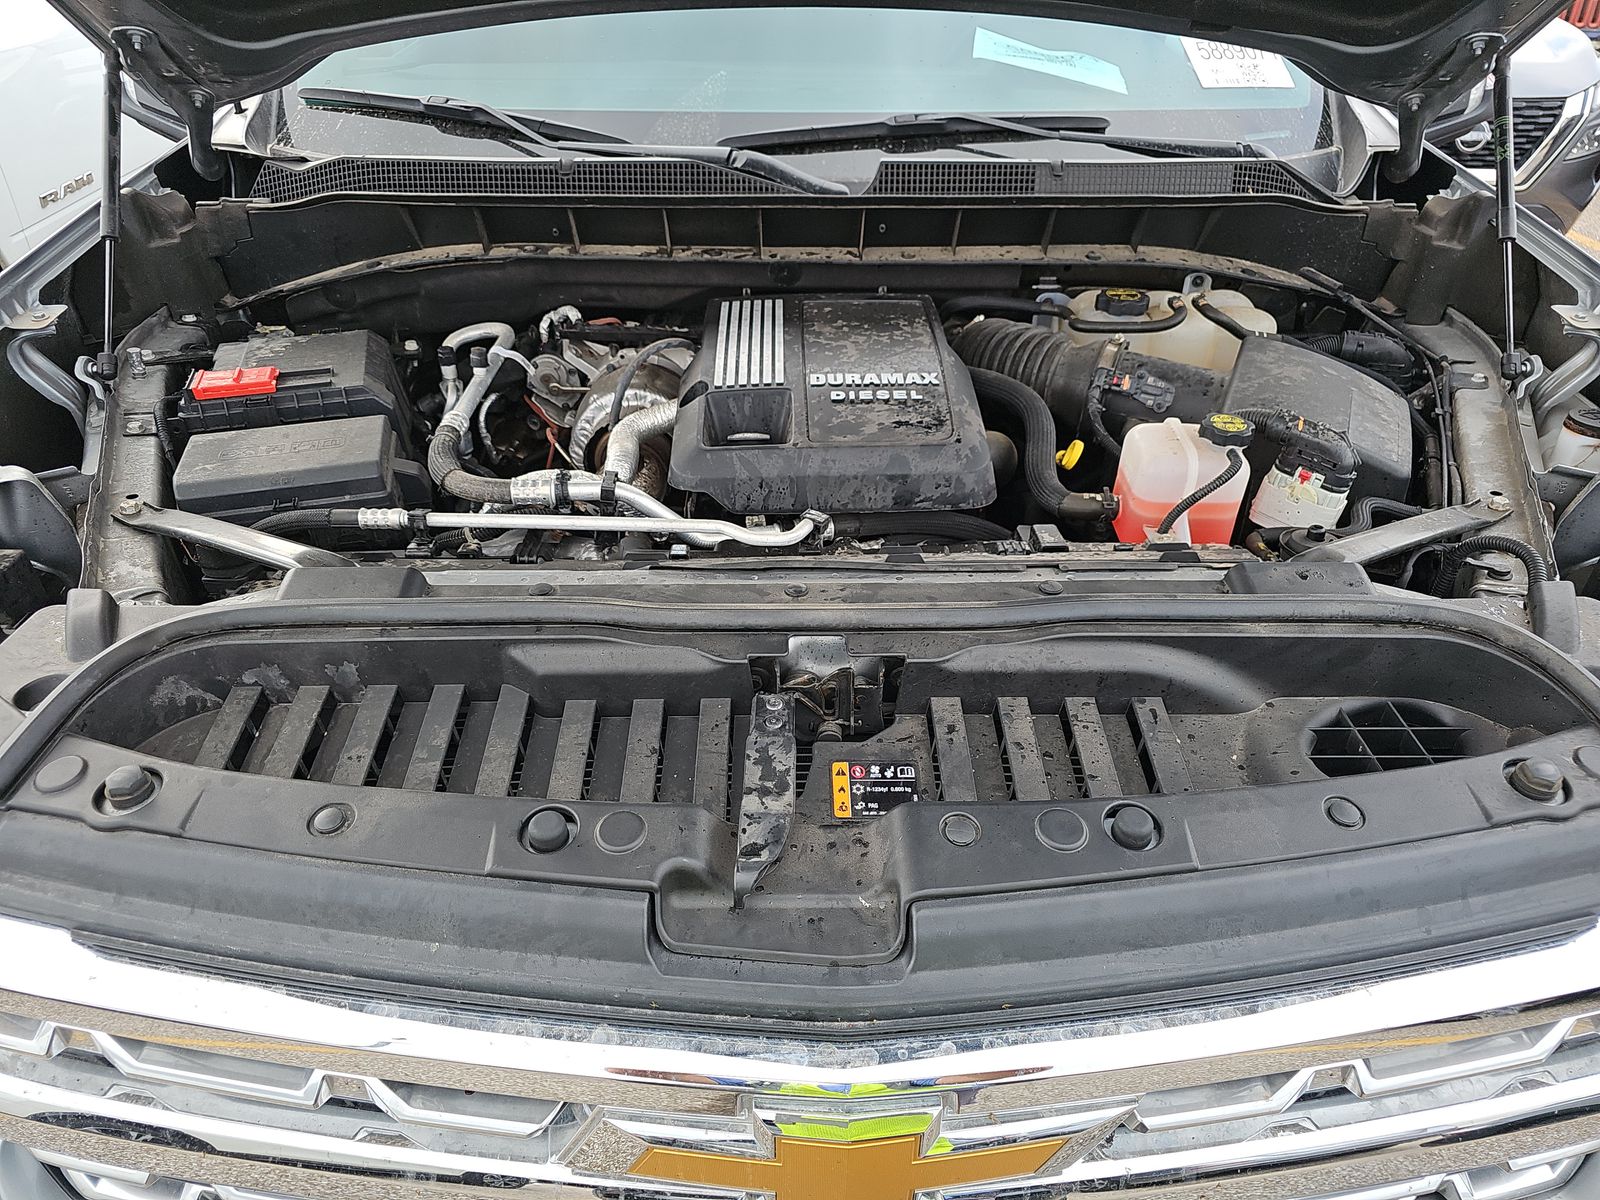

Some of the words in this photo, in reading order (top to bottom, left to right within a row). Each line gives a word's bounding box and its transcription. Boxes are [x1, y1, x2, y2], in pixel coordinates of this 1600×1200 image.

[39, 171, 95, 209] RAM
[809, 372, 940, 386] DURAMAX
[830, 389, 923, 403] DIESEL
